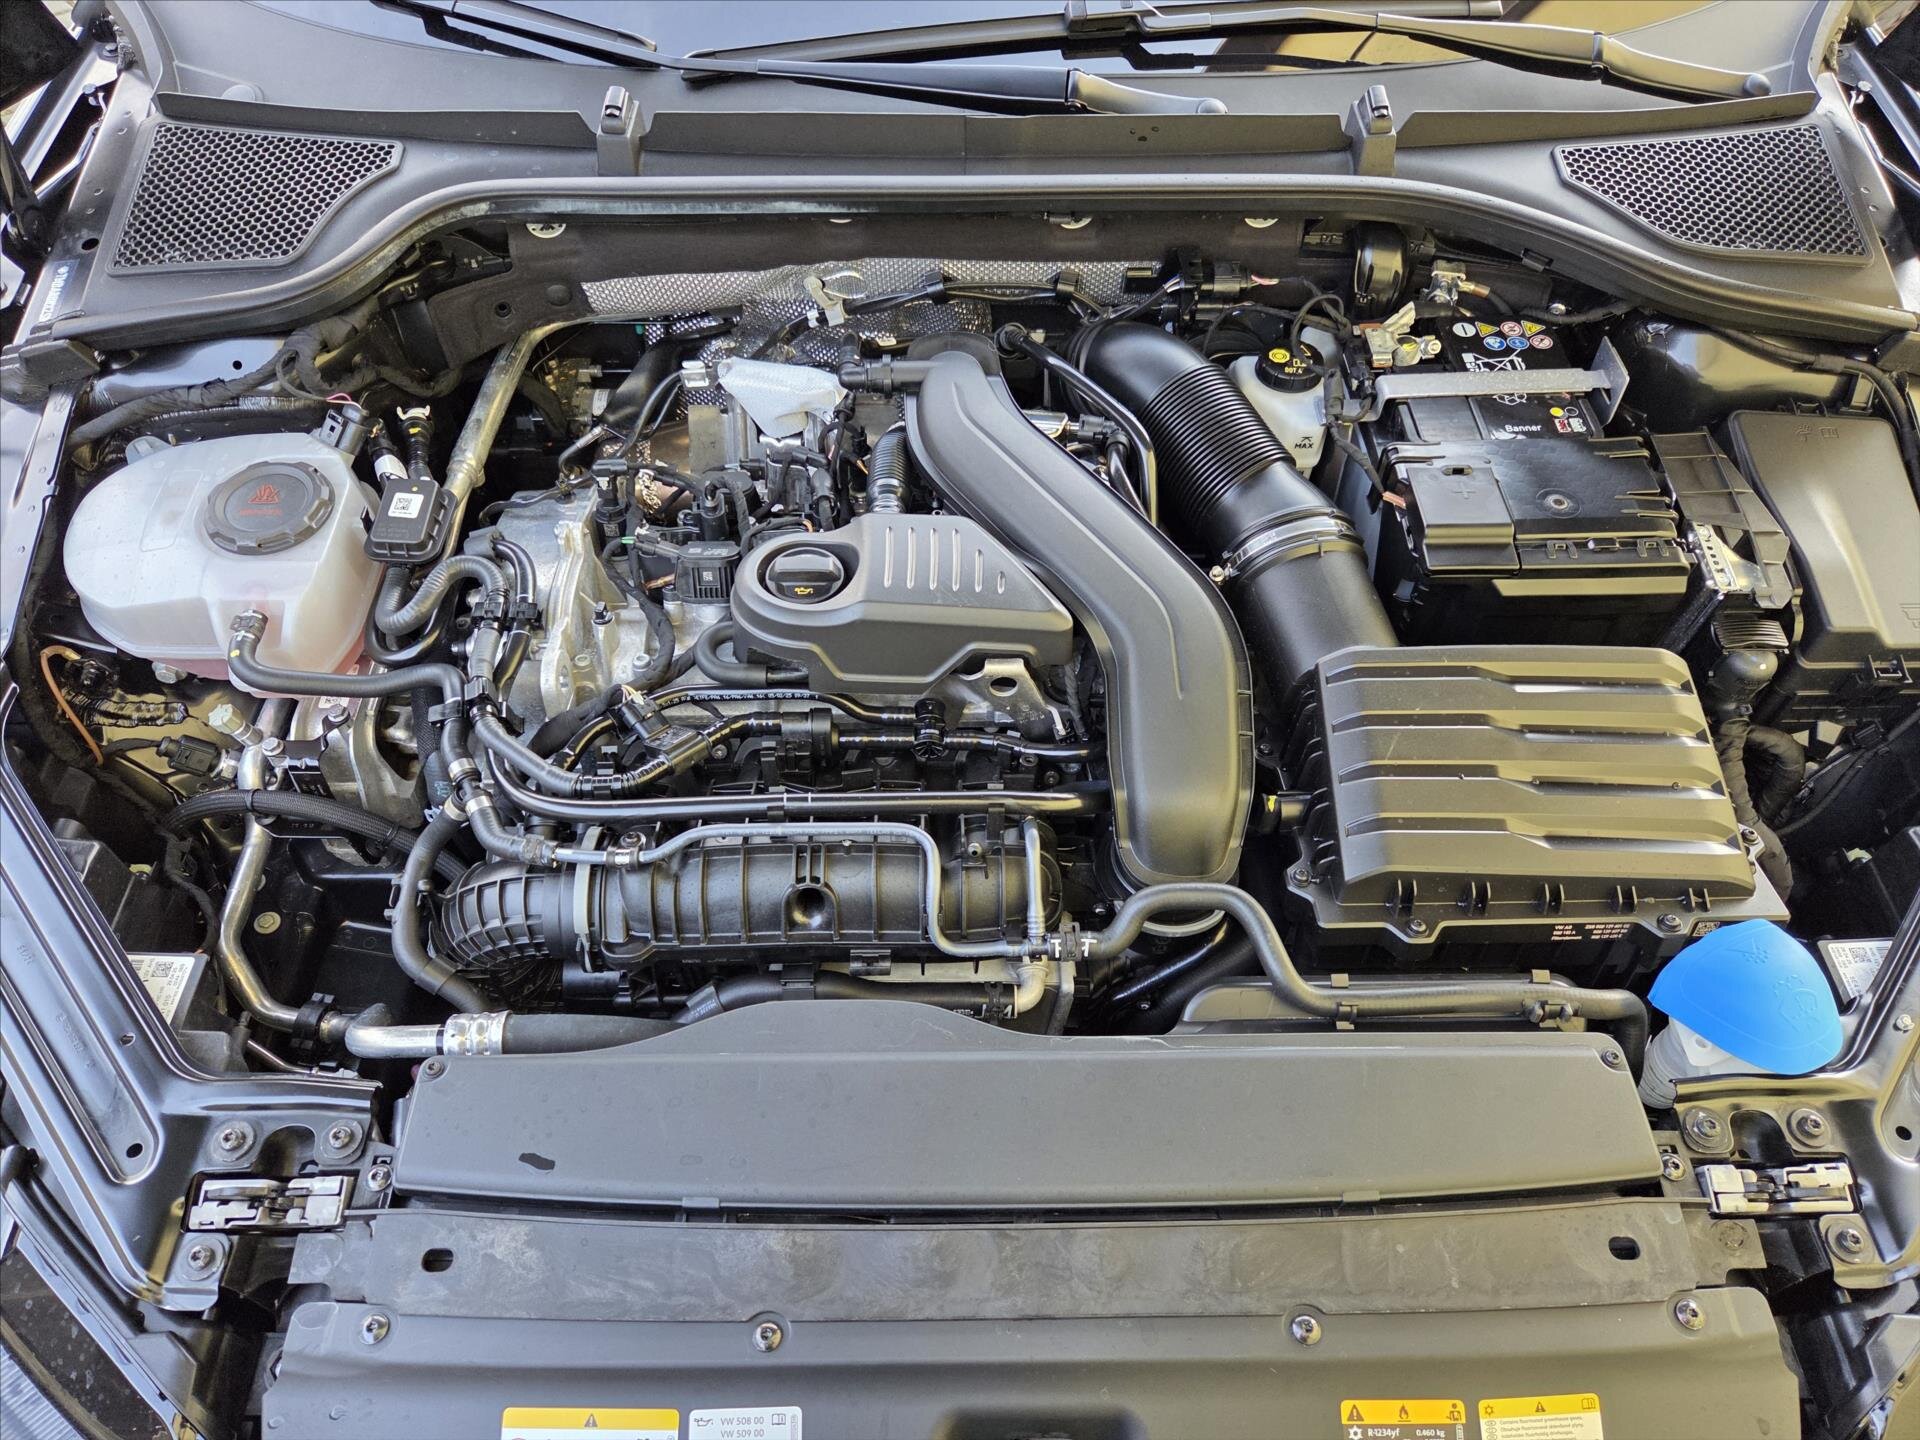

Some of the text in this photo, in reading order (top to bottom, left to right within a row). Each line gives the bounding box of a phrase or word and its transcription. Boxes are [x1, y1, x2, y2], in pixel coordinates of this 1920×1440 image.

[1504, 424, 1542, 433] Banner
[720, 1416, 765, 1426] VW 508 00
[720, 1429, 765, 1438] VW 509 00
[1367, 1428, 1400, 1439] R-1234yf
[1436, 1429, 1446, 1438] kg
